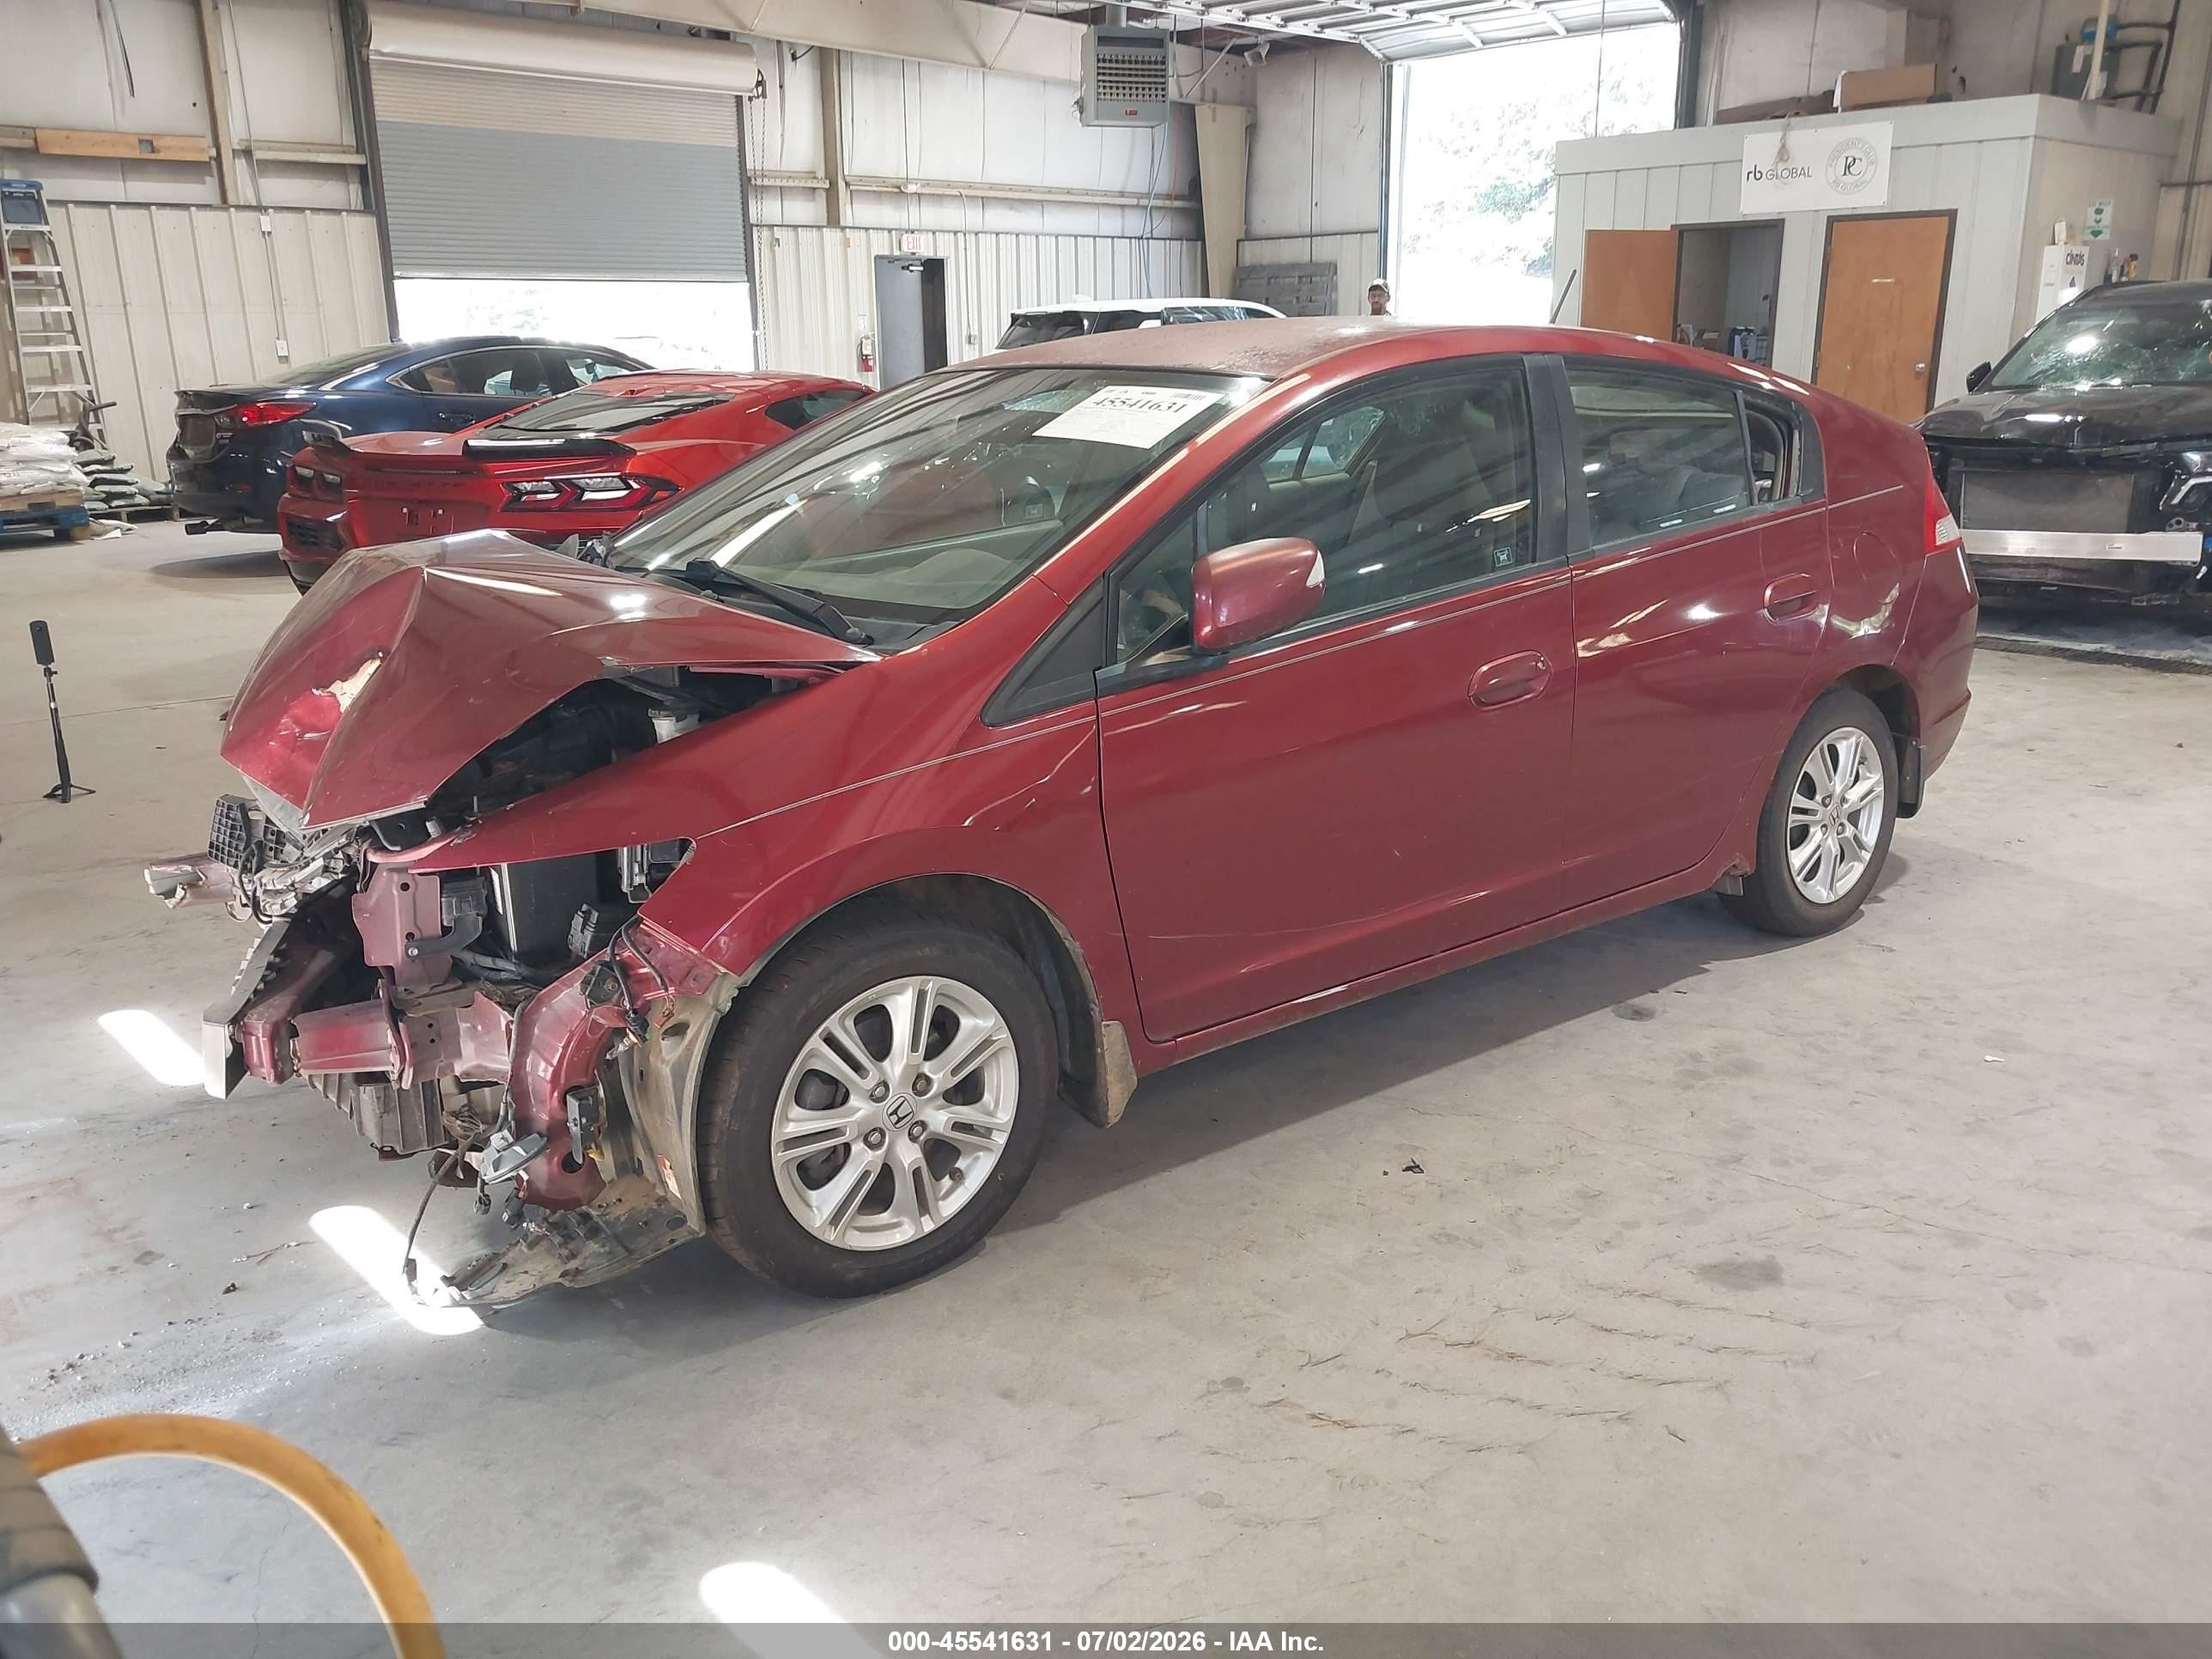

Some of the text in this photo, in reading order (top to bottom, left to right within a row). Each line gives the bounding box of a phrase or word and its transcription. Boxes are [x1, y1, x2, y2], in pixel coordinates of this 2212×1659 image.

[1747, 164, 1813, 182] rb GLOBAL
[1092, 396, 1188, 413] 45541631
